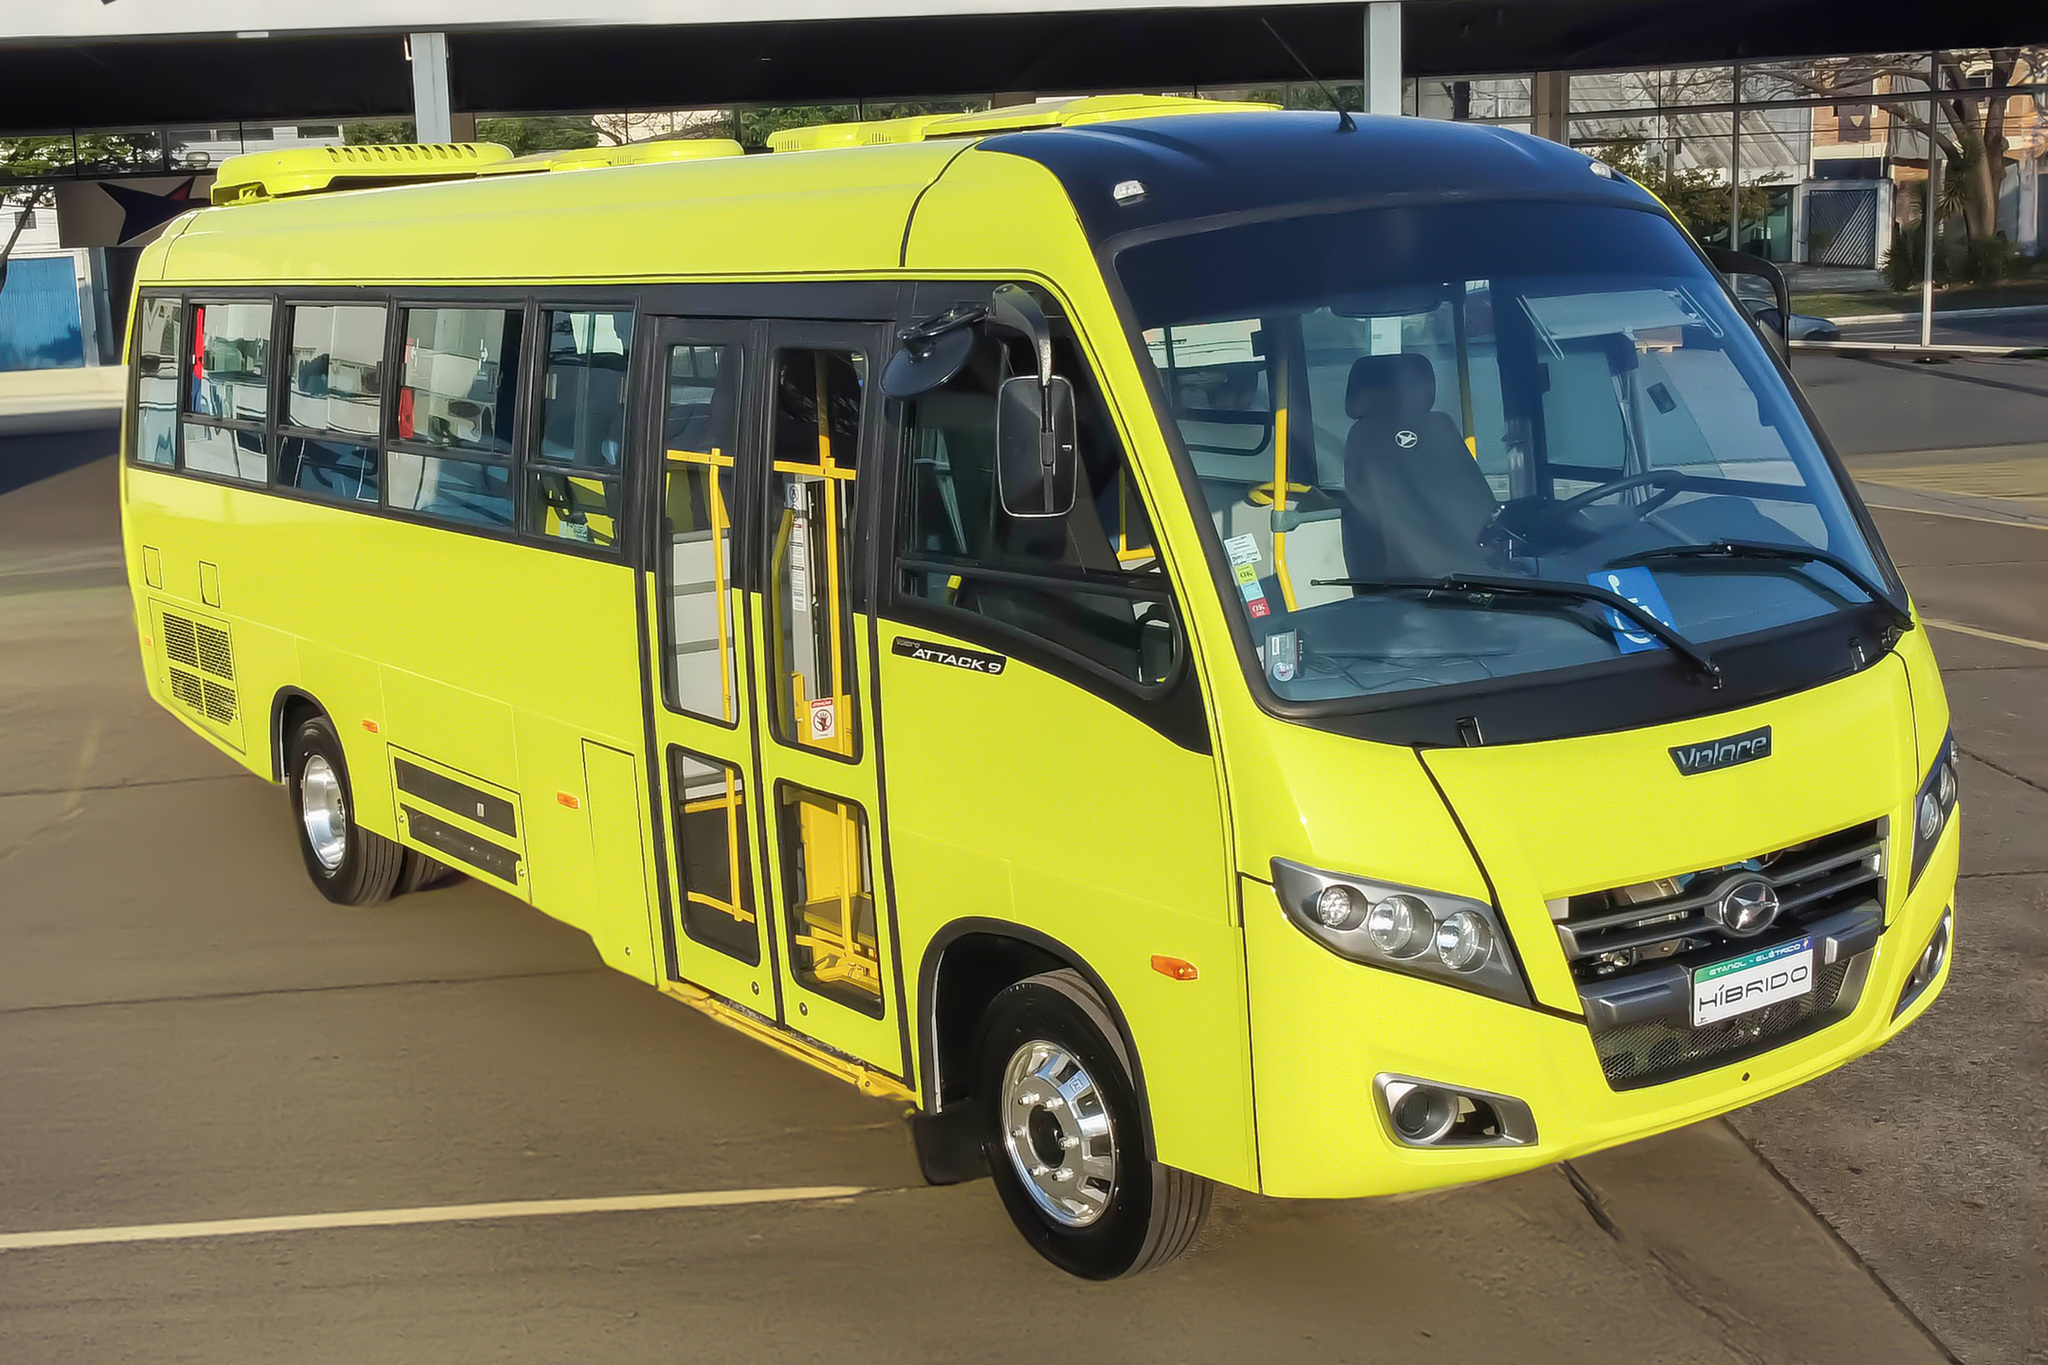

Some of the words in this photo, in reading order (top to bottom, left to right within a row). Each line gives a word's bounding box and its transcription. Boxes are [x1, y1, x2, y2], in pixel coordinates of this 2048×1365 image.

[1240, 570, 1253, 579] OK
[1252, 603, 1266, 613] OK
[912, 648, 985, 671] ATTACK
[988, 662, 1002, 673] 9
[1676, 736, 1767, 769] Volare
[1755, 943, 1801, 962] ELÉTRICO
[1698, 965, 1808, 1012] HÍBRIDO
